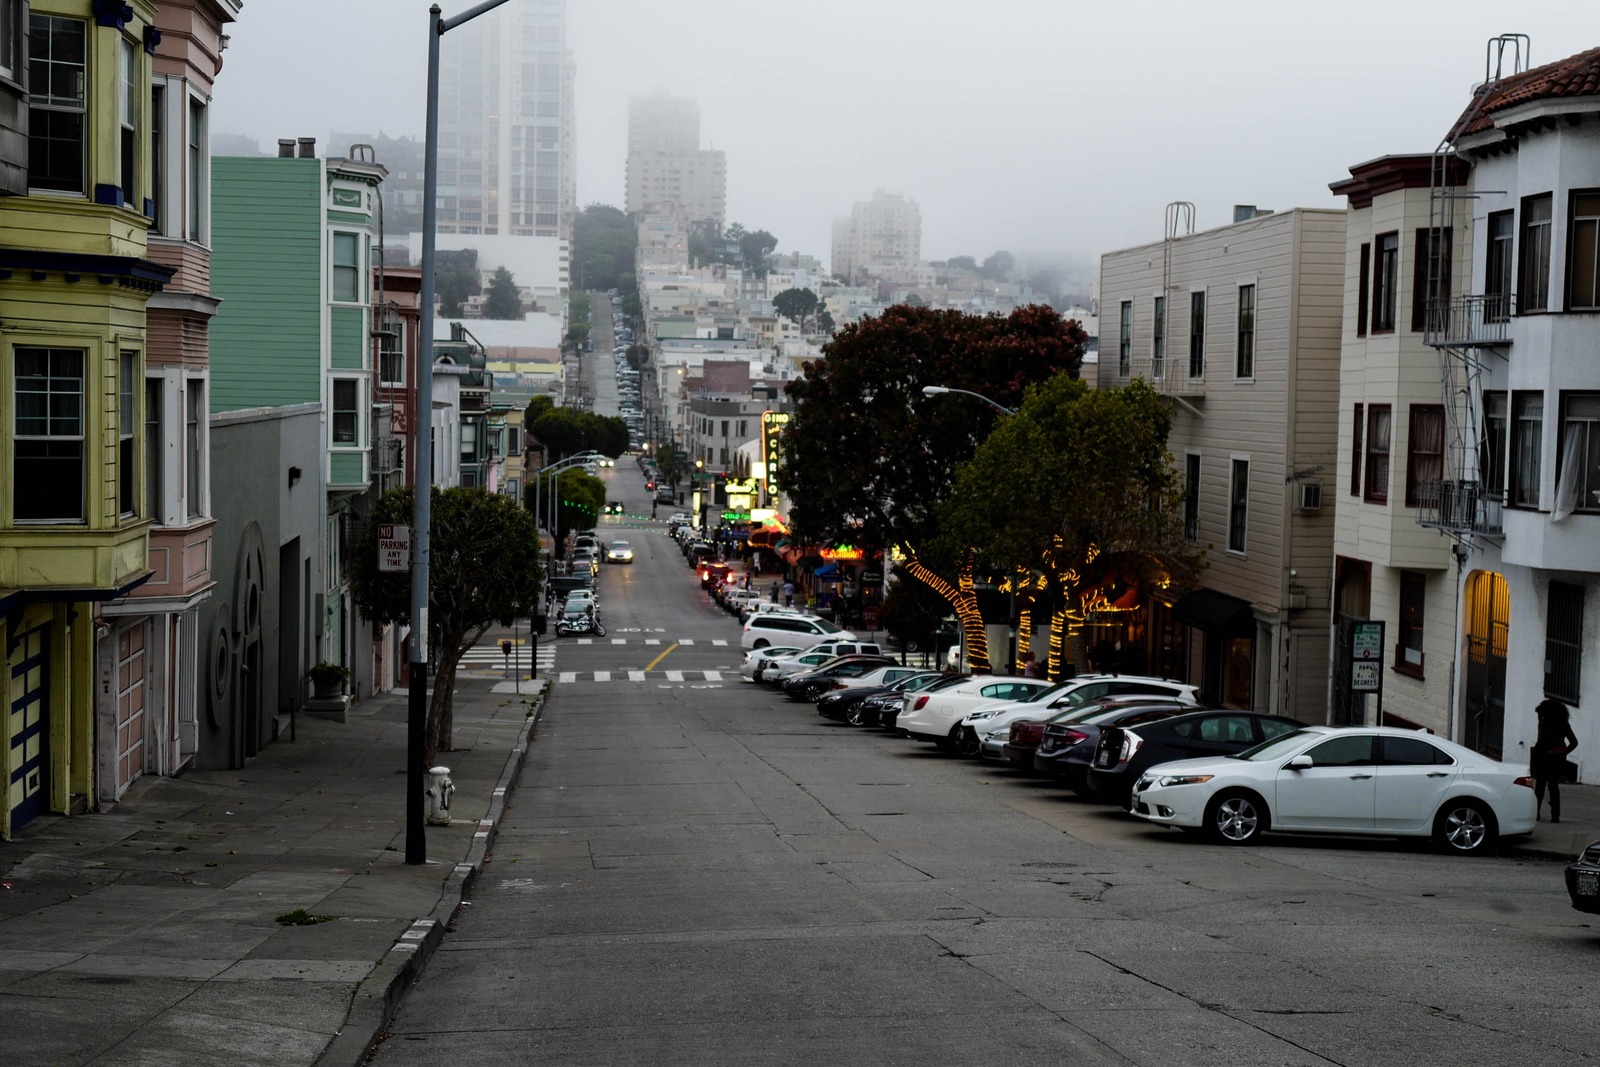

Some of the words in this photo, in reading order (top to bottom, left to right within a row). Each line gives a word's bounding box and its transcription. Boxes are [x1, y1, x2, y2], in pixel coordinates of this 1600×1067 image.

[764, 413, 789, 423] GINO
[769, 438, 778, 495] CARLO
[380, 526, 391, 538] NO
[380, 540, 408, 550] PARKING
[864, 612, 878, 620] STO
